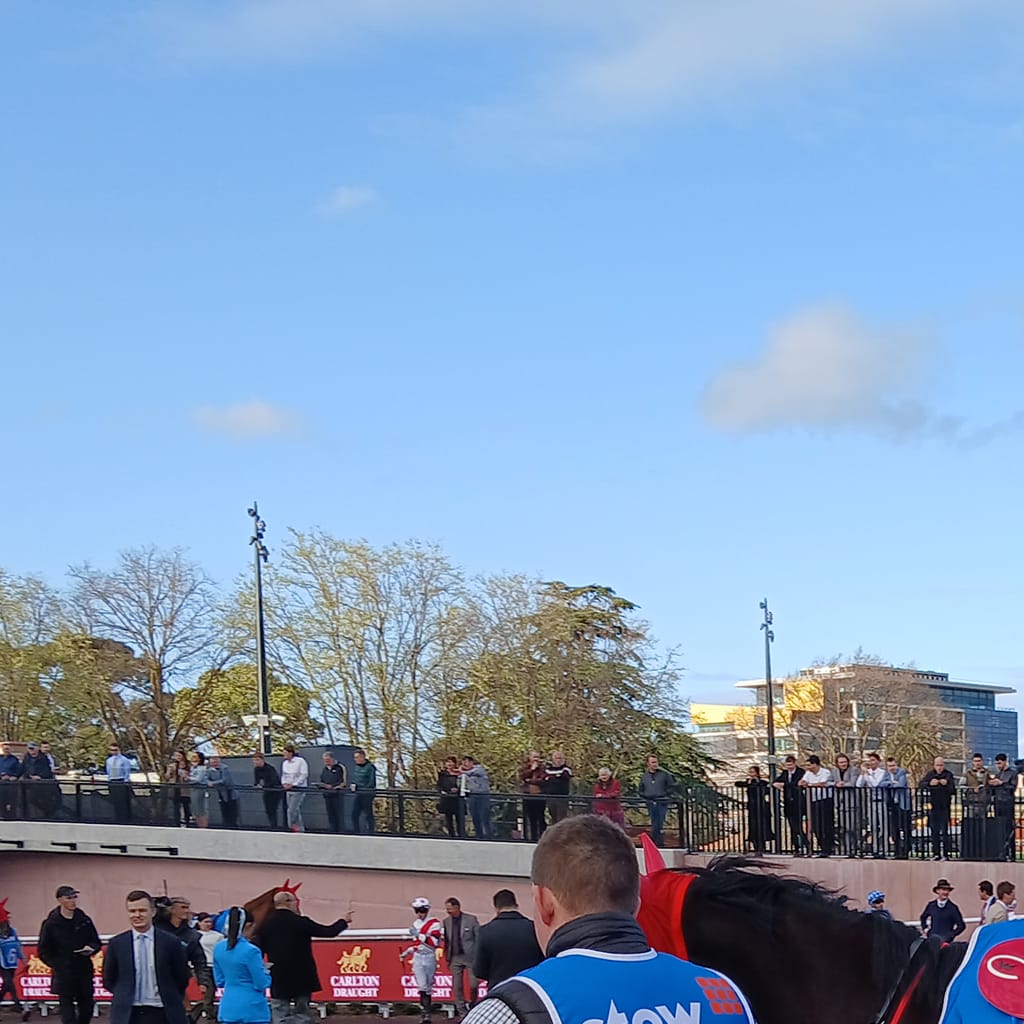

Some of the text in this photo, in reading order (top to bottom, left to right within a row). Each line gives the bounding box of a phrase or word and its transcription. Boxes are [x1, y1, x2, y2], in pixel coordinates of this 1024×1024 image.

[20, 976, 52, 987] CARLT
[330, 975, 380, 987] CARLTON
[401, 975, 453, 988] CAON
[333, 987, 379, 998] DRAUGHT
